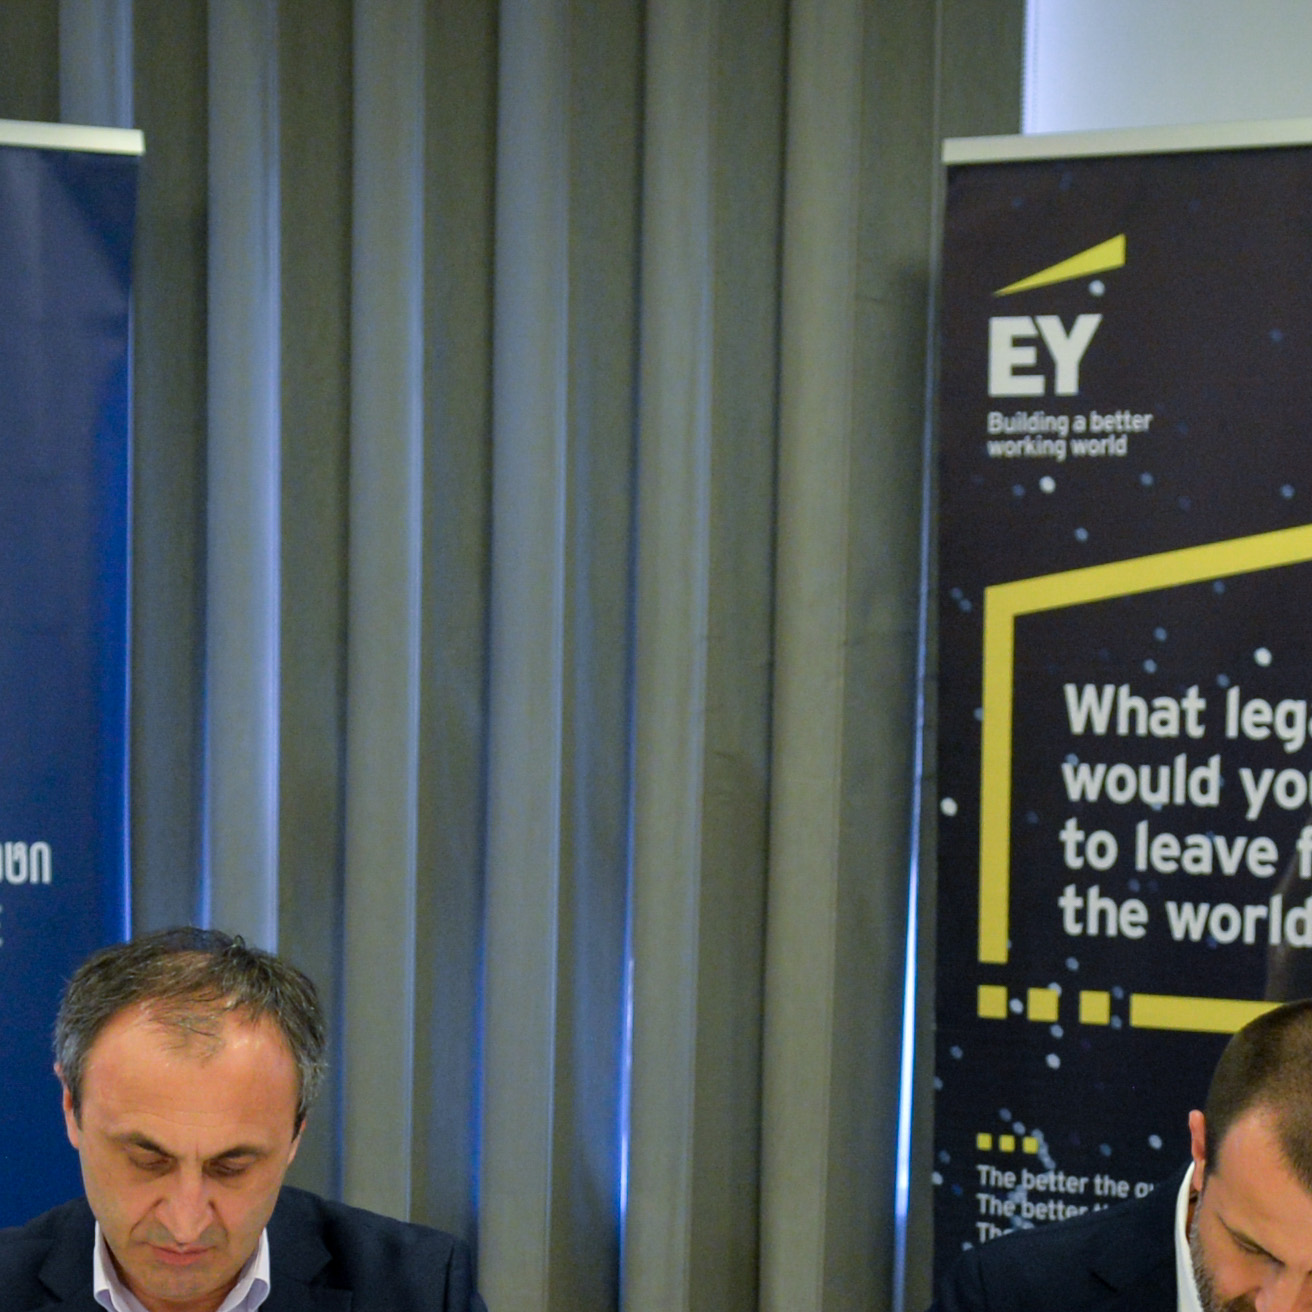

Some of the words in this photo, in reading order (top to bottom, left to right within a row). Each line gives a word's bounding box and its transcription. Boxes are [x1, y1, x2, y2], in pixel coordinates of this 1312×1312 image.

[989, 314, 1102, 397] EY
[987, 411, 1069, 438] Building
[1072, 414, 1086, 433] a
[1089, 410, 1153, 433] better
[987, 435, 1066, 461] working
[1069, 434, 1128, 457] world
[1064, 683, 1206, 740] What
[1061, 754, 1221, 807] would
[1059, 817, 1118, 871] to
[1136, 820, 1279, 878] leave
[1058, 884, 1149, 939] the
[976, 1164, 1016, 1189] The
[1021, 1168, 1089, 1194] better
[1094, 1173, 1129, 1198] the
[976, 1193, 1016, 1217] The
[1021, 1199, 1088, 1221] better
